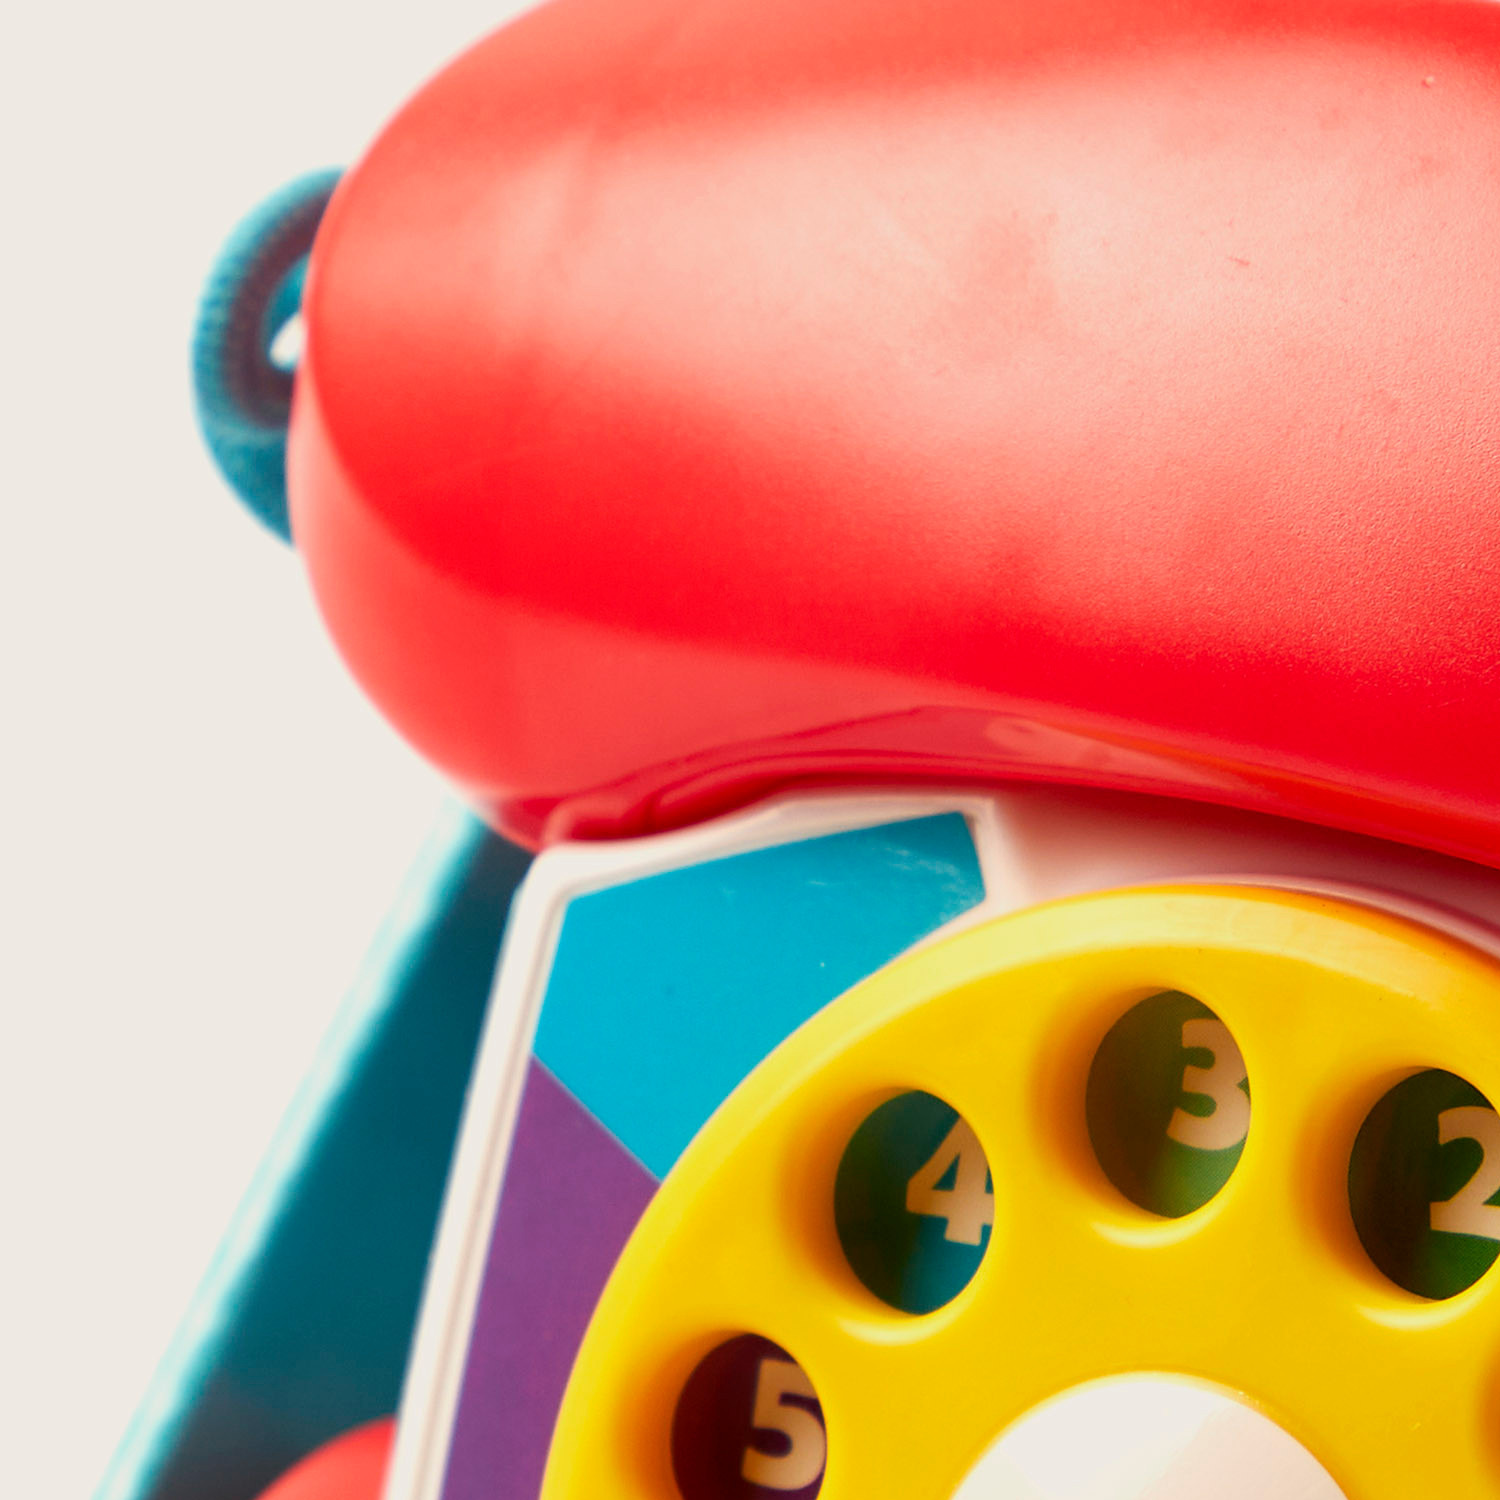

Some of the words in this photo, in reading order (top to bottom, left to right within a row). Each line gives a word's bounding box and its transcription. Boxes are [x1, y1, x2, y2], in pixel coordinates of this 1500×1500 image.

[1166, 1018, 1252, 1151] 3
[906, 1114, 995, 1246] 4
[741, 1357, 828, 1491] 5
